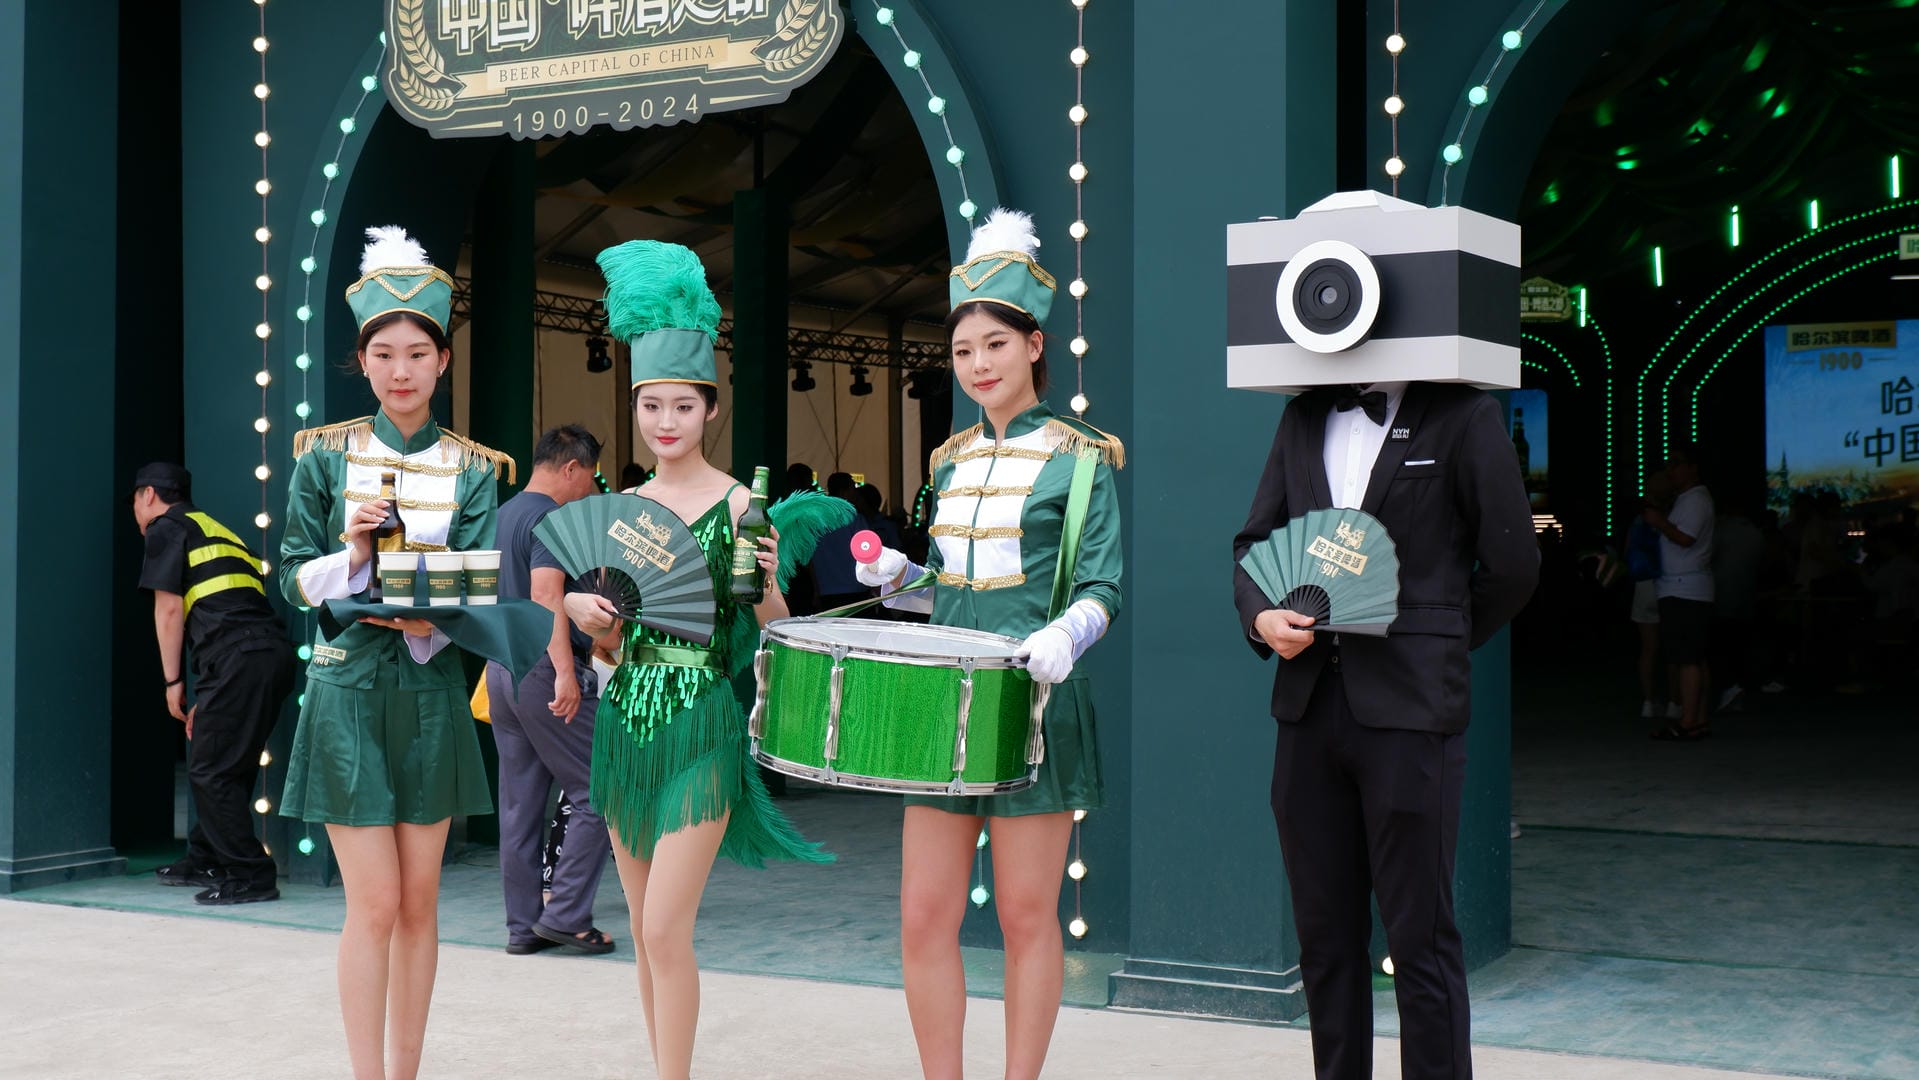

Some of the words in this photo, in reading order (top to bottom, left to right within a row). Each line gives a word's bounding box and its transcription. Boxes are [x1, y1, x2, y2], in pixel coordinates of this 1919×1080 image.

[498, 65, 541, 82] BEER
[548, 55, 621, 77] CAPITAL
[629, 52, 651, 68] OF
[659, 44, 715, 64] CHINA
[513, 93, 699, 133] 1900-2024
[1881, 376, 1919, 416] 哈
[622, 547, 646, 569] 1900
